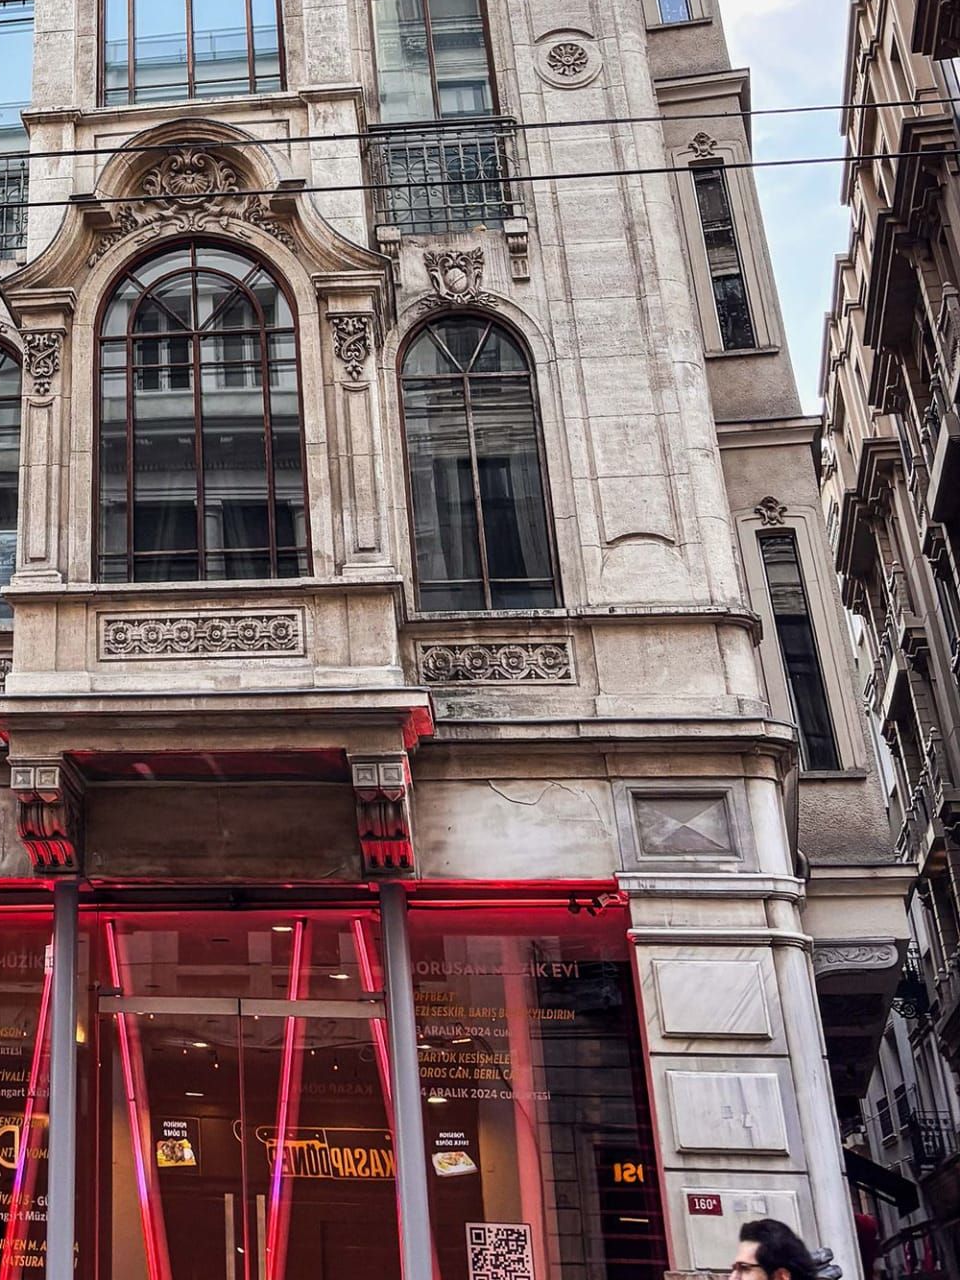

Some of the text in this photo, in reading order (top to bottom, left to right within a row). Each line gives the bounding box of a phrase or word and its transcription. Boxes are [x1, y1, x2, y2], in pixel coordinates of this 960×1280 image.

[552, 960, 579, 978] EVİ
[464, 1026, 491, 1037] 2024
[418, 1067, 447, 1079] OROS
[429, 1087, 469, 1099] ARALIK
[471, 1088, 498, 1099] 2024
[25, 1211, 49, 1222] Müzi
